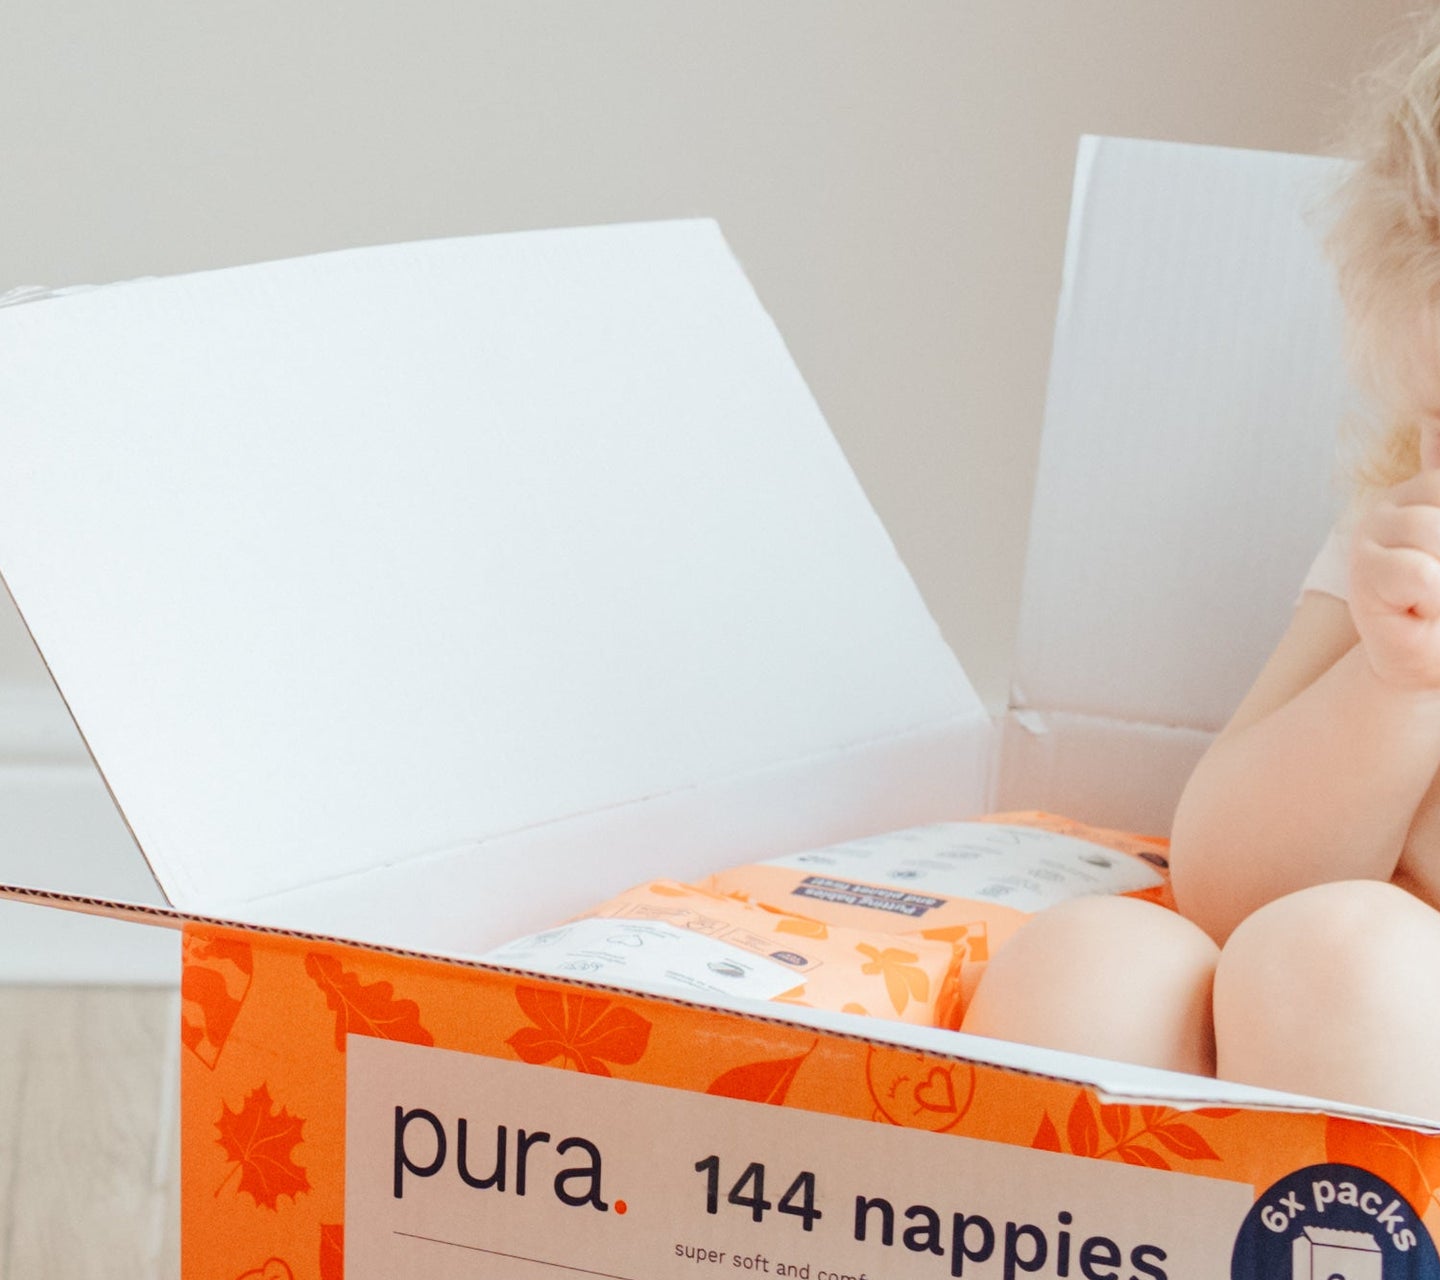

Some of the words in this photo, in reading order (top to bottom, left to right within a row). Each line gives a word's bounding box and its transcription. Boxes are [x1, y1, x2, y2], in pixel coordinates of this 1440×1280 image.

[393, 1105, 628, 1215] pura.
[694, 1154, 822, 1232] 144
[1261, 1191, 1305, 1233] 6x
[1311, 1180, 1417, 1252] packs
[674, 1243, 726, 1264] super
[732, 1253, 769, 1273] soft
[776, 1262, 810, 1280] and
